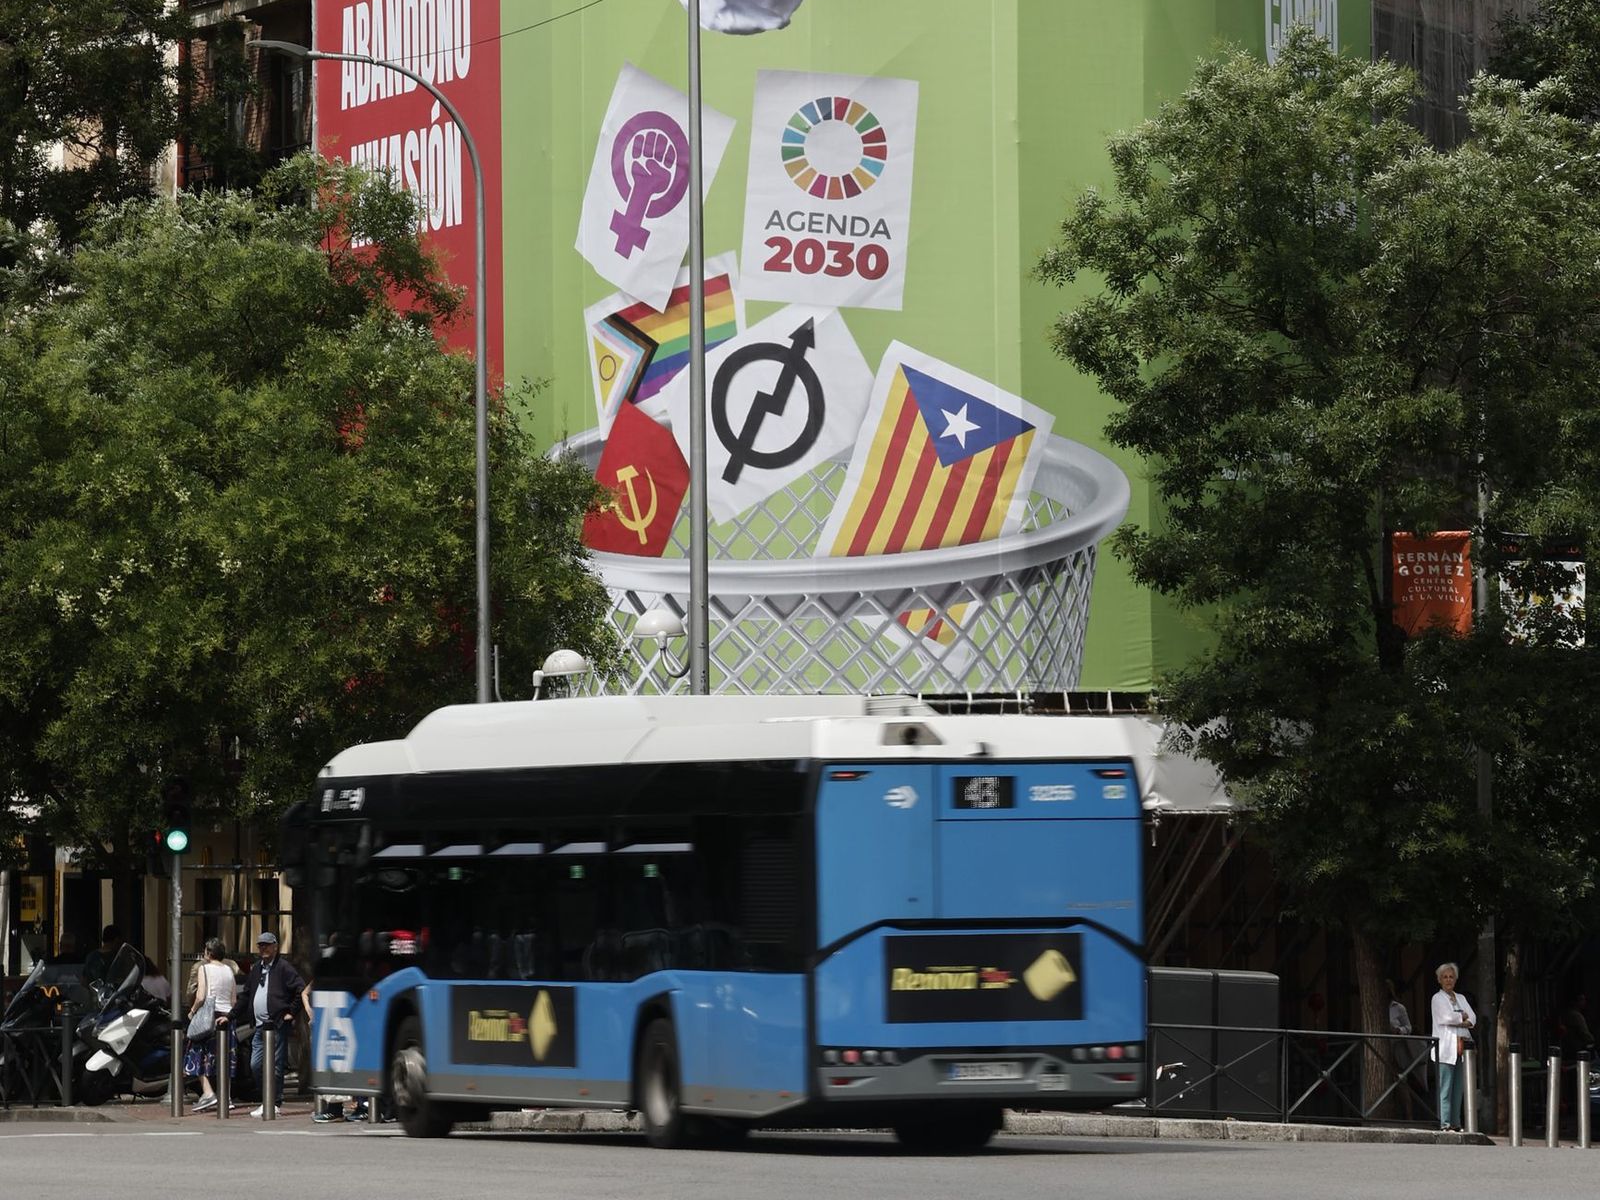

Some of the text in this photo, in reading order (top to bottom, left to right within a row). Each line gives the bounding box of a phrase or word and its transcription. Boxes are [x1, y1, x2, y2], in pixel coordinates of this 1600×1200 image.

[764, 210, 892, 240] AGENDA
[763, 236, 889, 281] 2030
[1397, 550, 1463, 564] FERNÁN
[1399, 562, 1465, 577] GÓMEZ
[1408, 585, 1459, 594] CULTURAL
[1438, 594, 1465, 603] VILLA
